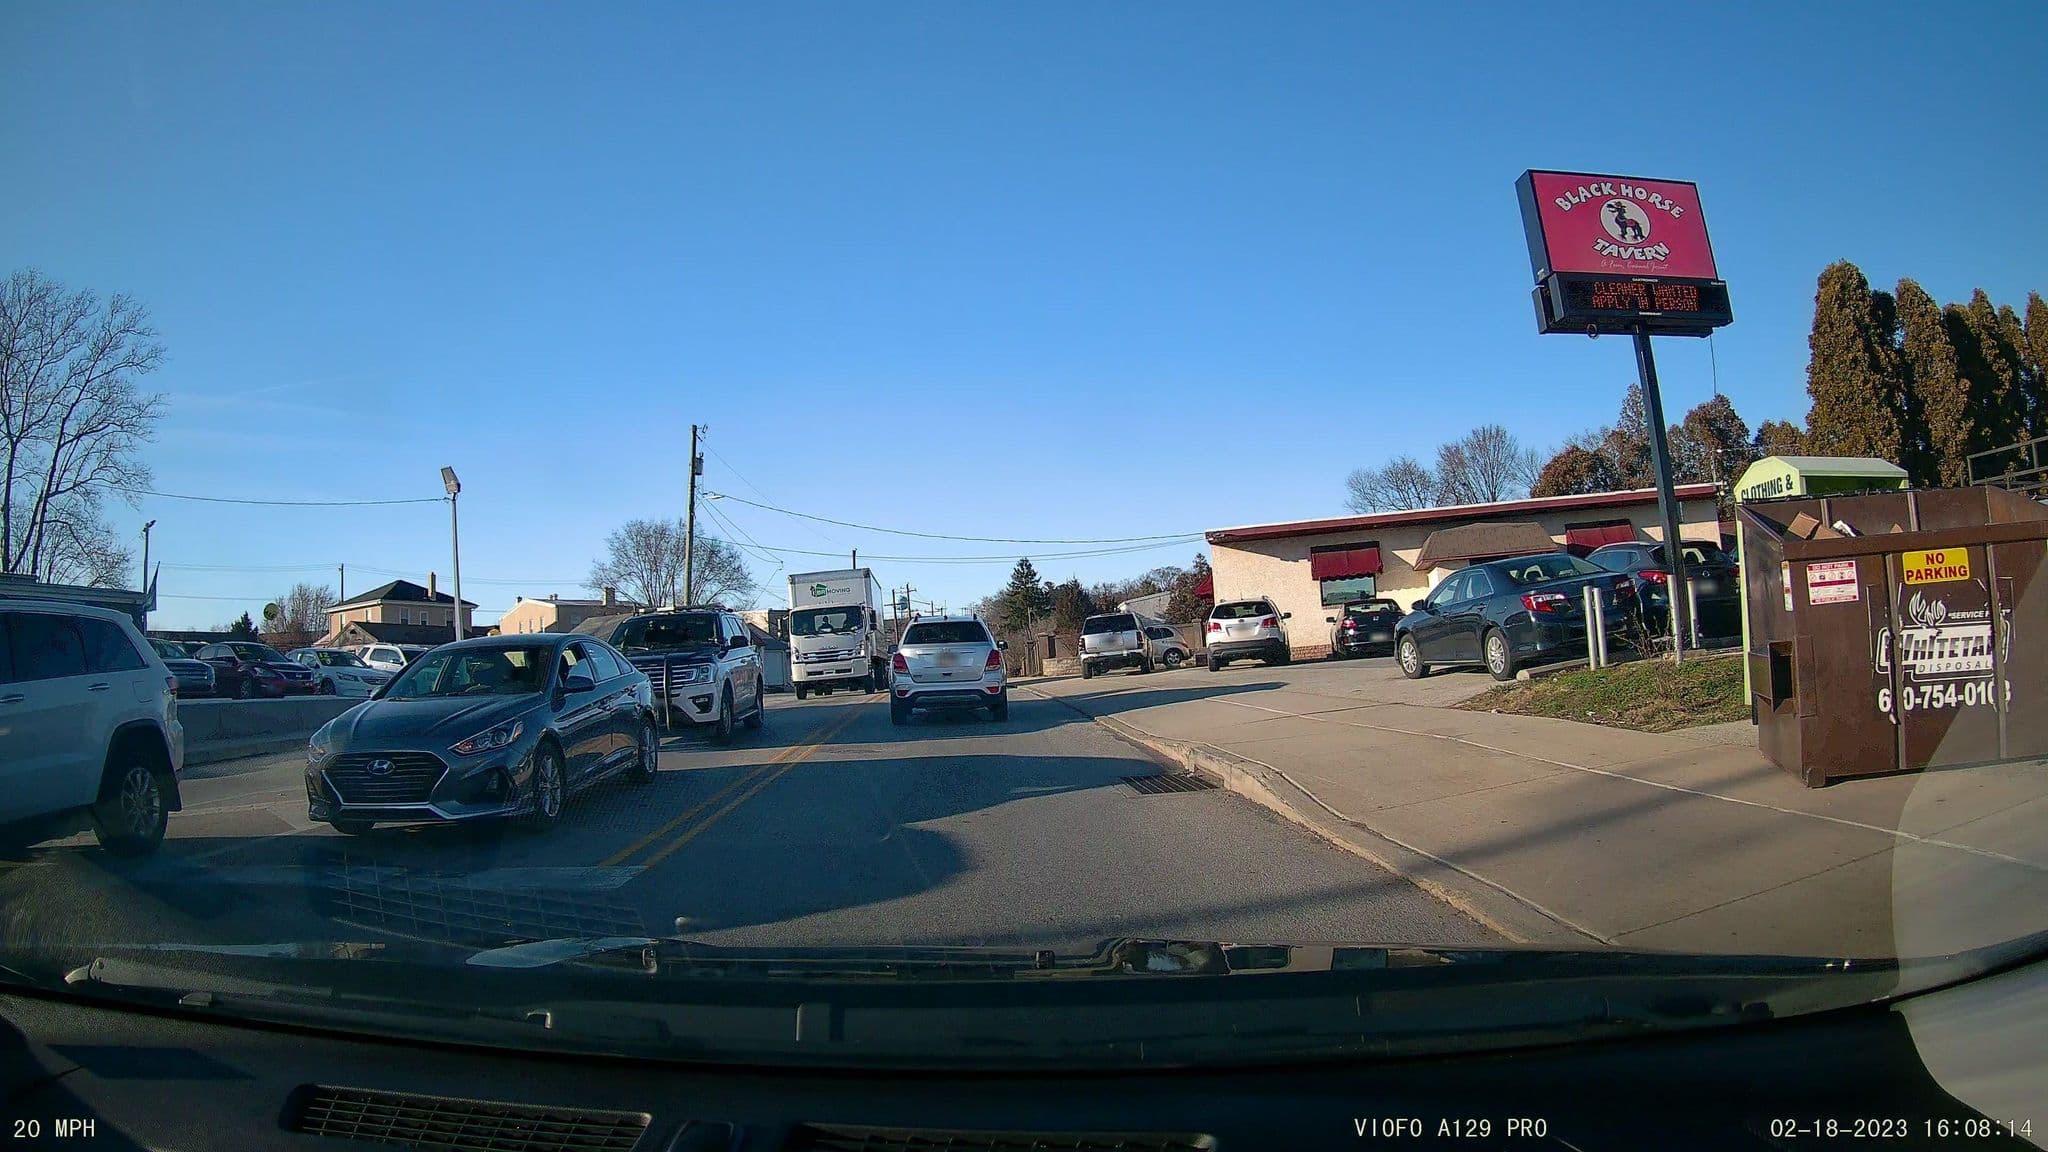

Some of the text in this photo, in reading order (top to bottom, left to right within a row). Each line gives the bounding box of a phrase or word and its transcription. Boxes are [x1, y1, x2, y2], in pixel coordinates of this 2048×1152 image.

[1555, 182, 1684, 218] BLACK HORSE
[1593, 238, 1670, 261] TAVERN
[1594, 282, 1697, 299] CLEANER WANTED
[1592, 295, 1698, 311] APPLY IN PERSON
[1741, 474, 1794, 500] CLOTHING &
[1925, 553, 1945, 565] NO
[1906, 565, 1968, 582] PARKING
[1918, 661, 1991, 673] DISPOSAL
